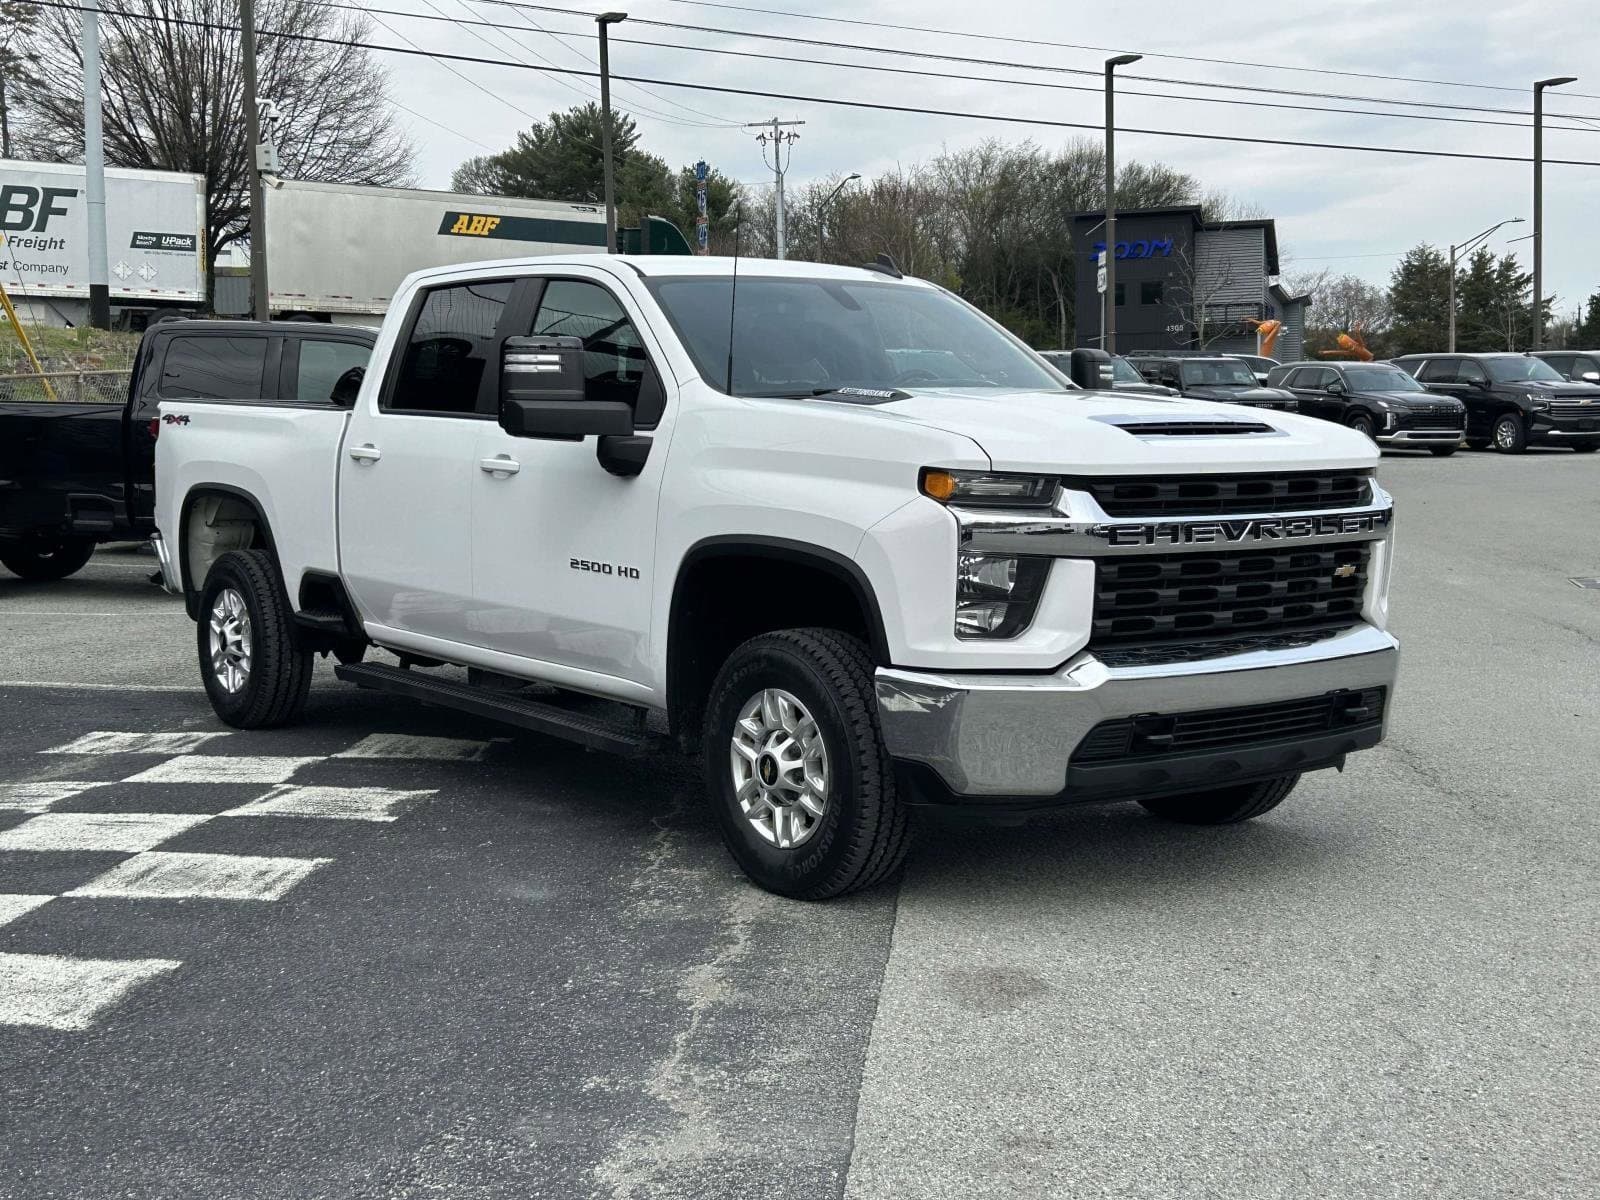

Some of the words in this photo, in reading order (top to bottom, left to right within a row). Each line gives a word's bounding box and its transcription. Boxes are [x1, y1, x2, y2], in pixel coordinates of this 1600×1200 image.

[0, 185, 78, 233] BF
[450, 215, 501, 236] ABF
[8, 235, 66, 251] Freight
[13, 261, 69, 276] Company
[1108, 512, 1382, 546] CHEVROLET
[570, 558, 612, 574] 2500
[617, 565, 640, 579] HD
